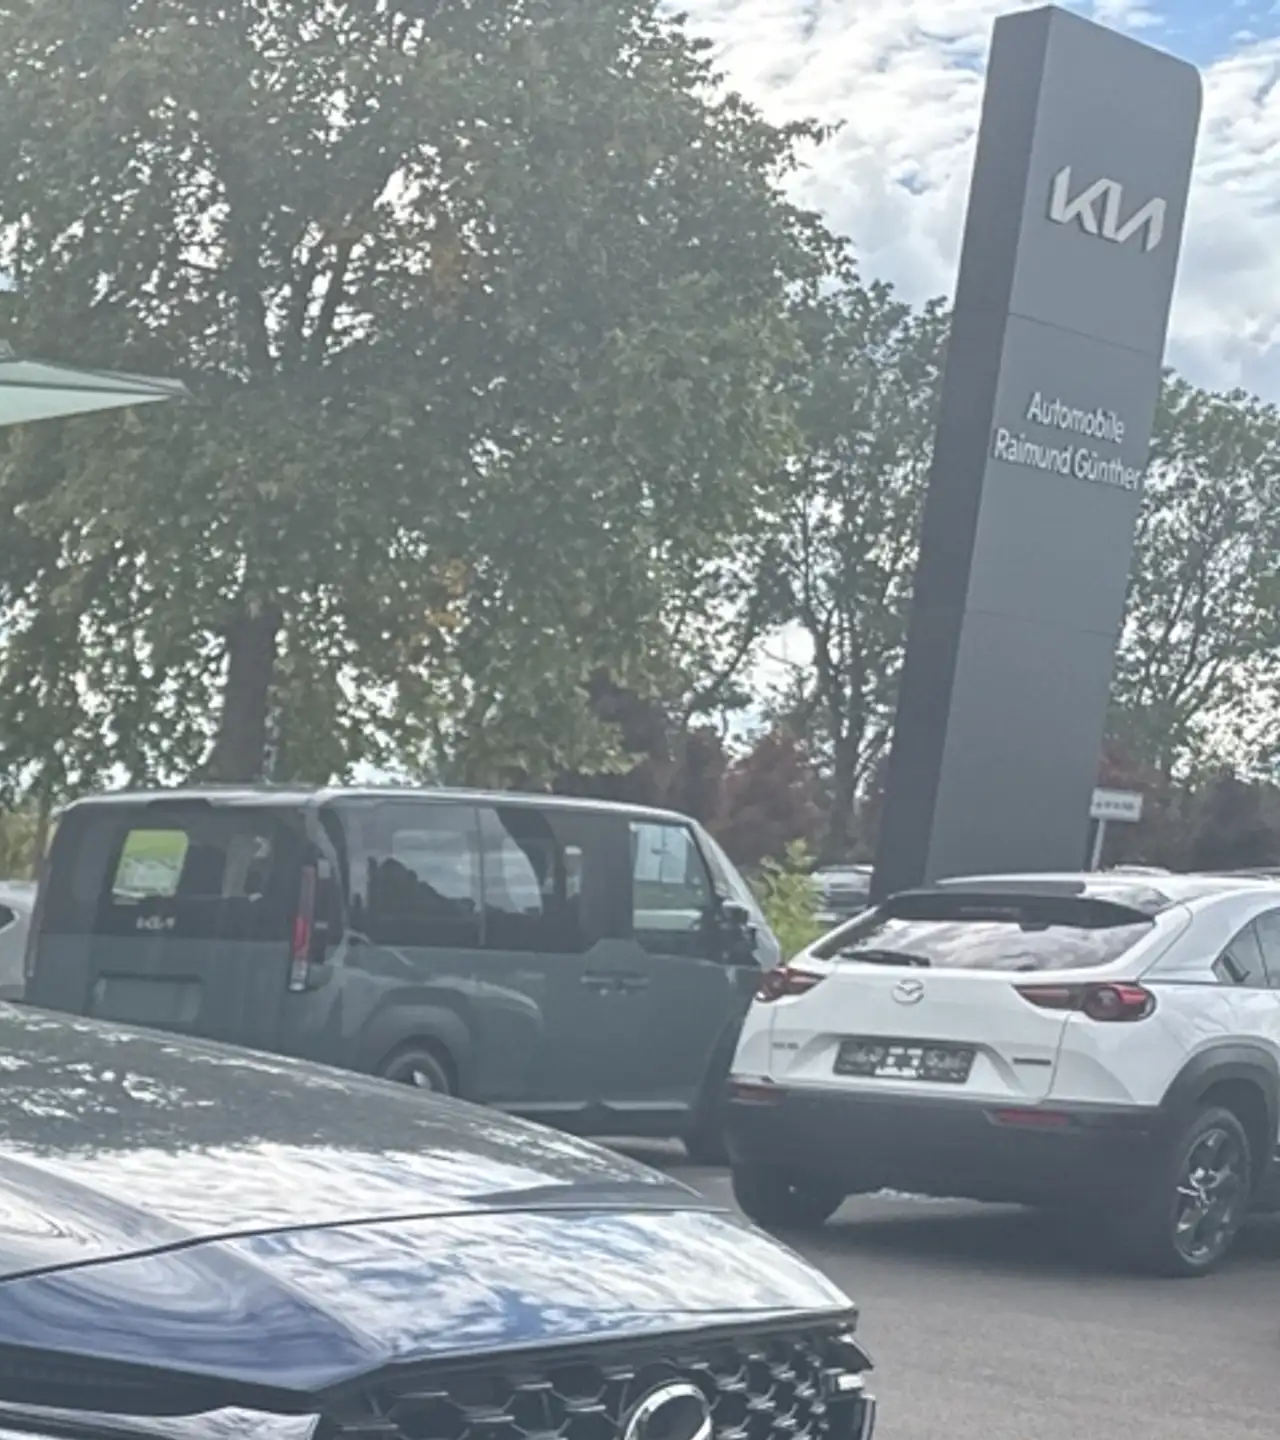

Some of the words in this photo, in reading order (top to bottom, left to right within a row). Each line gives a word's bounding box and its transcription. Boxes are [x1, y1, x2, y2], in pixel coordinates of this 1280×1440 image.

[1048, 165, 1167, 252] KIA
[1026, 391, 1124, 445] Automobile
[994, 427, 1074, 474] Raimund
[1074, 448, 1141, 490] Günther
